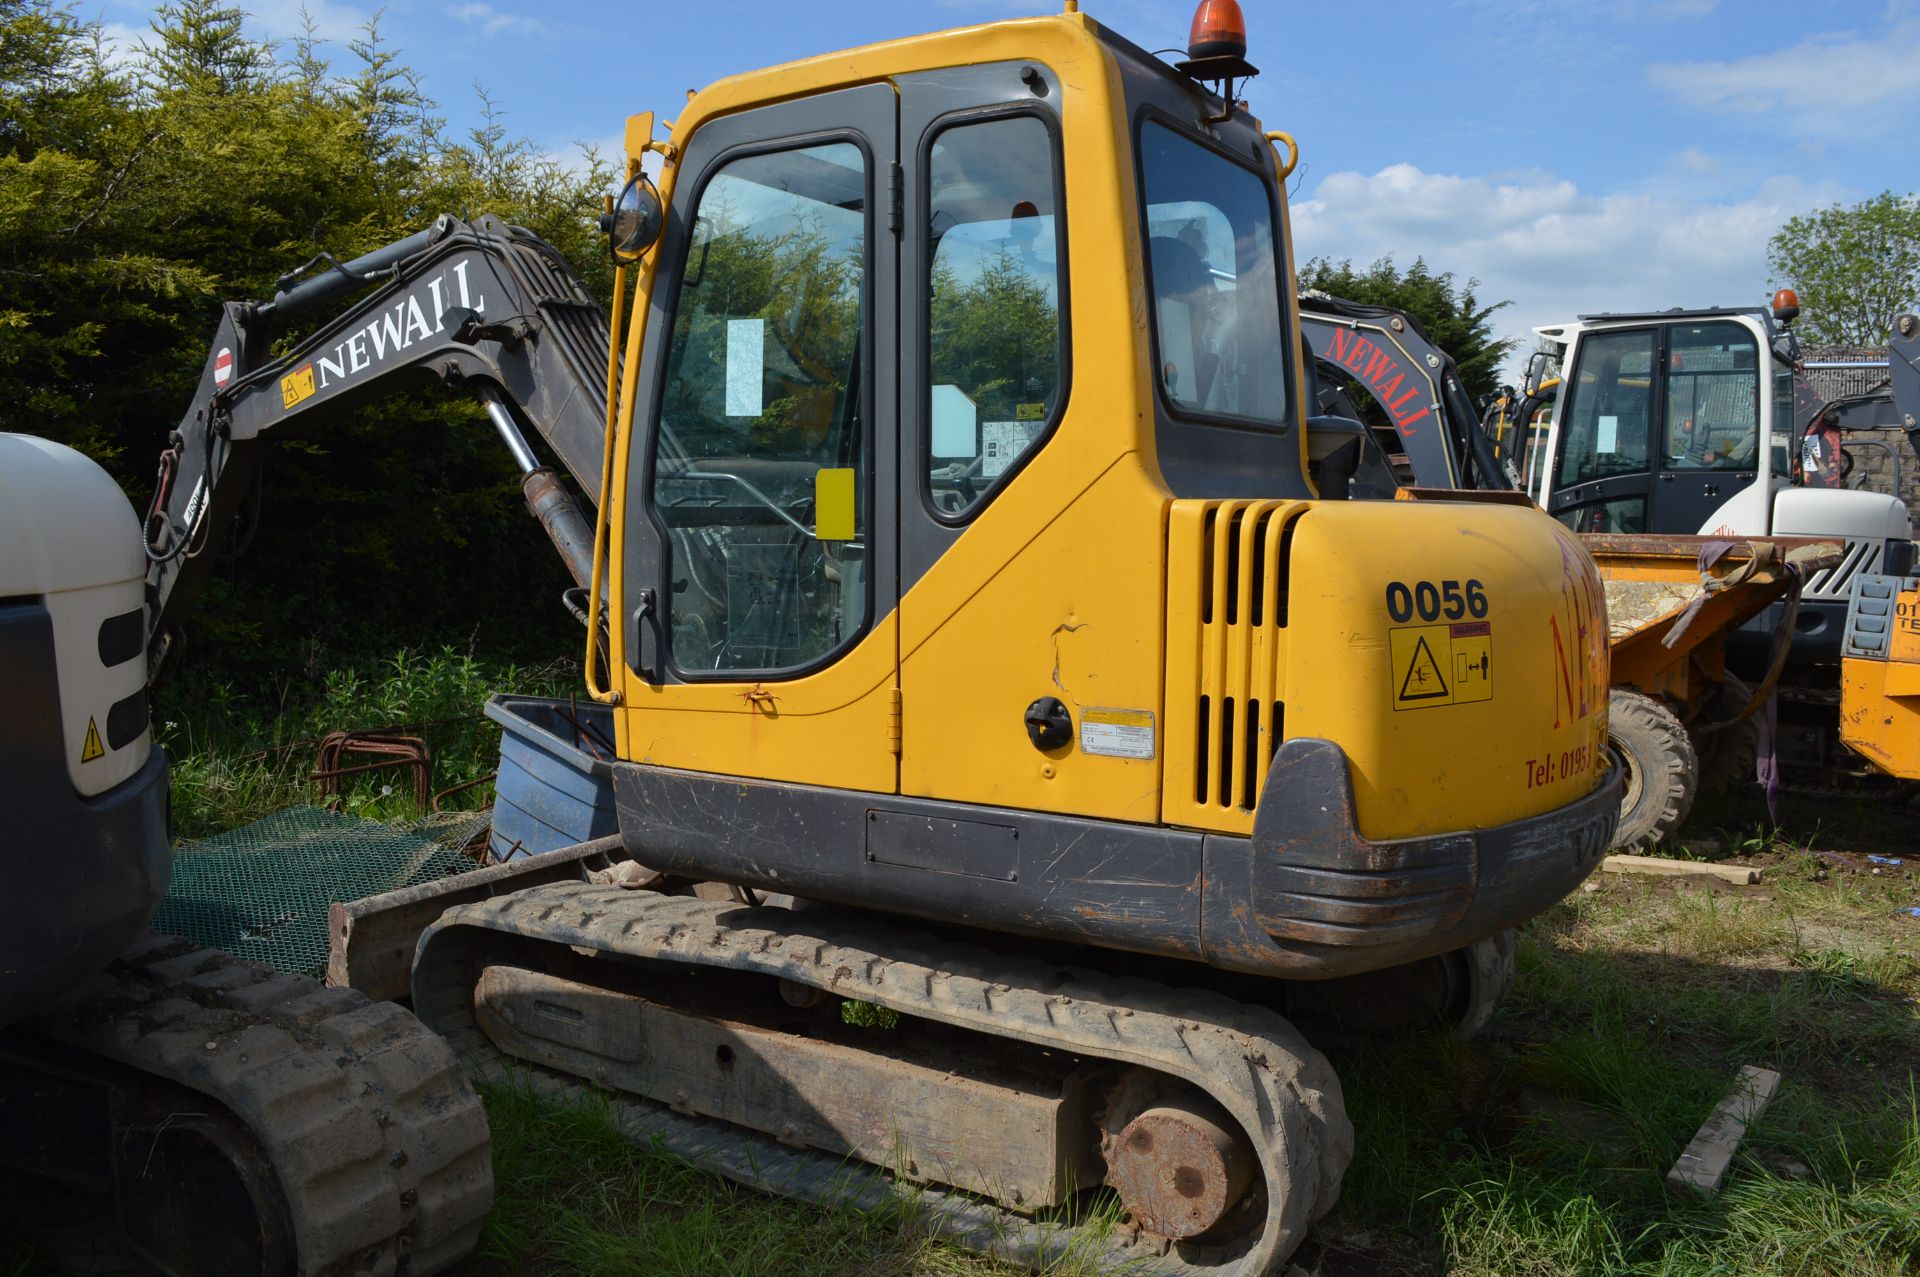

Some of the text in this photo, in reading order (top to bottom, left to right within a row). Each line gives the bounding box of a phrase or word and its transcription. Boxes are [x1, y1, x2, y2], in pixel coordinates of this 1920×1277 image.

[316, 259, 485, 389] NEWALL
[1323, 326, 1430, 437] NEWALL
[1385, 578, 1489, 623] 0056
[1525, 752, 1556, 789] Tel:
